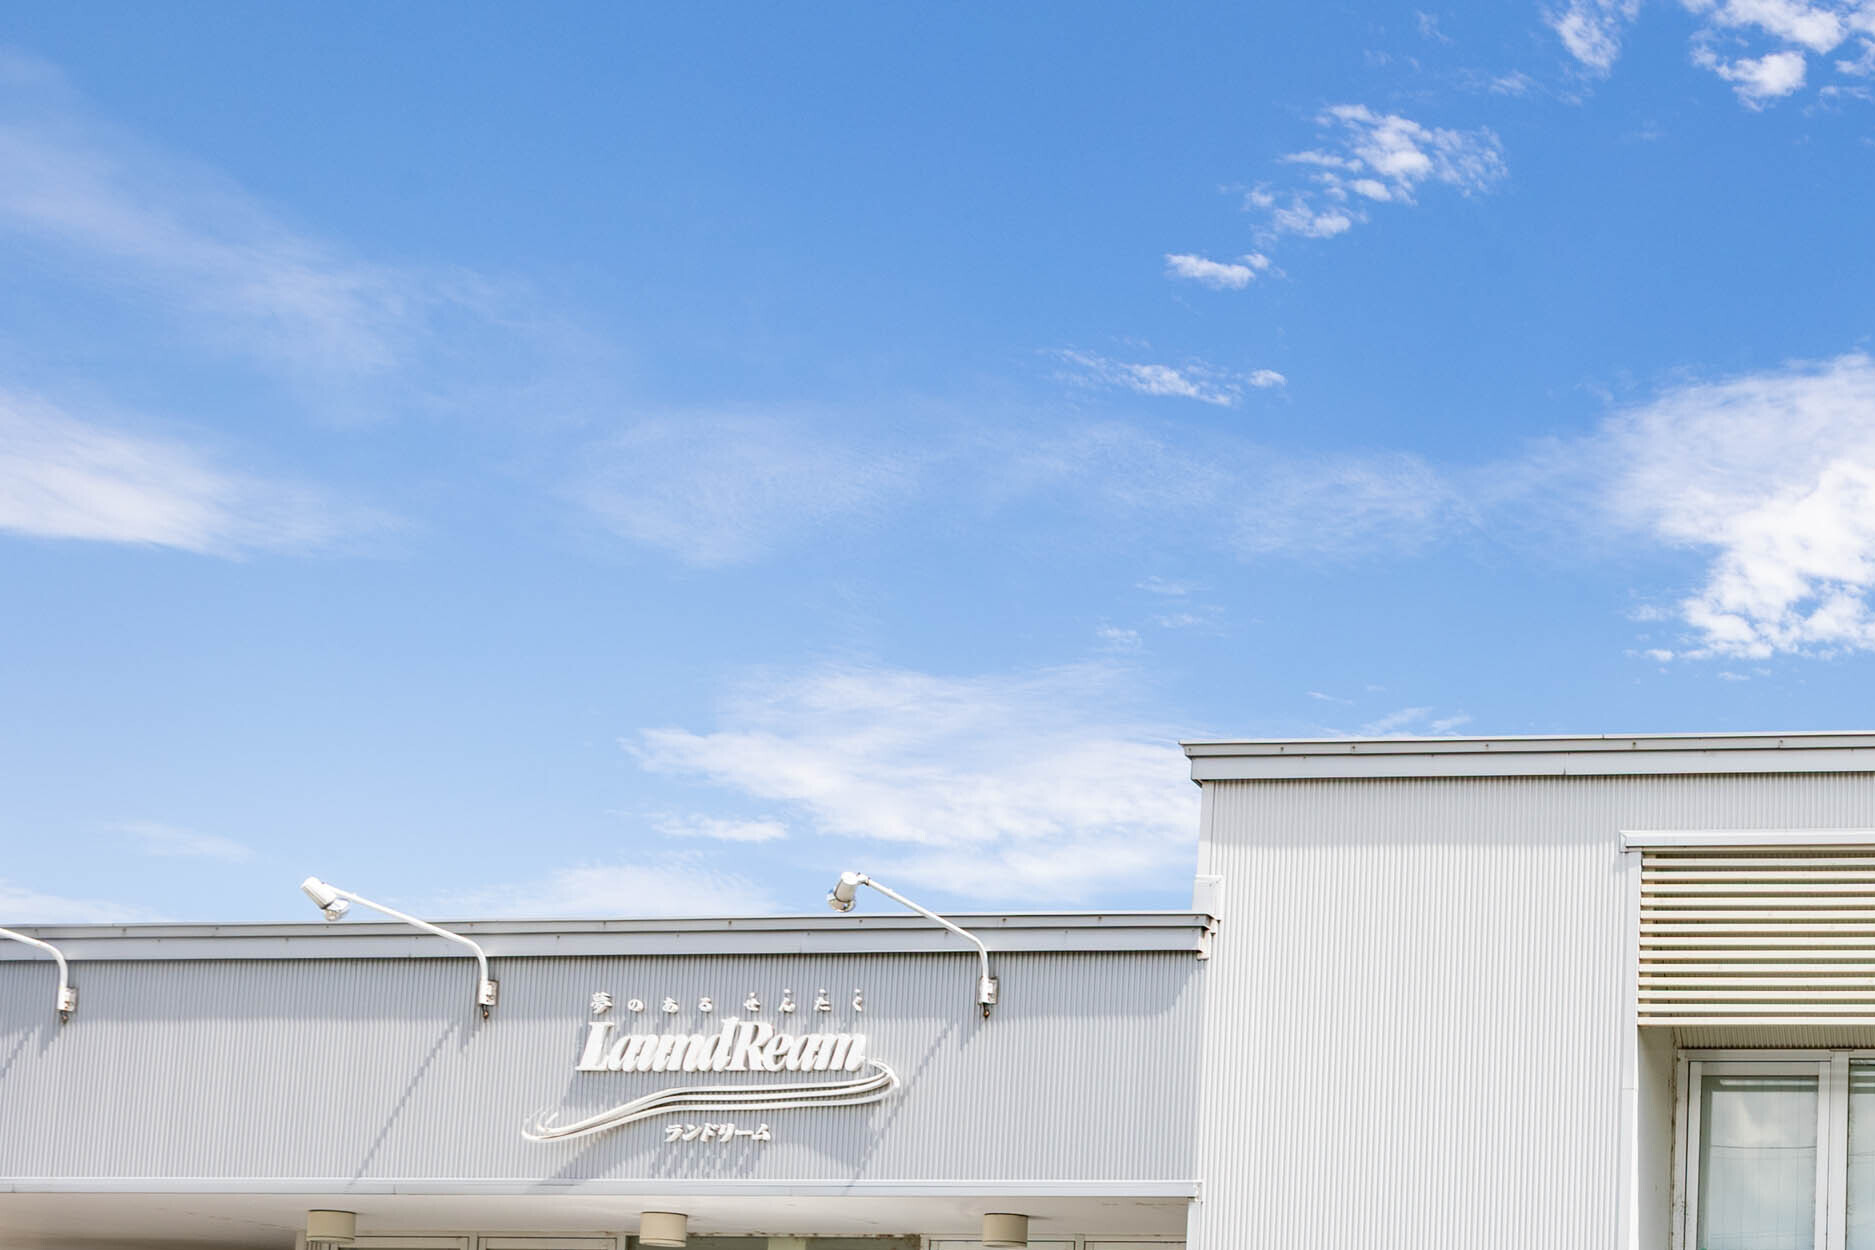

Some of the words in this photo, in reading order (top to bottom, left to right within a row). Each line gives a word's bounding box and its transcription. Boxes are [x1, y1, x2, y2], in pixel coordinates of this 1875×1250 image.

[664, 1122, 772, 1143] ランドリーム
